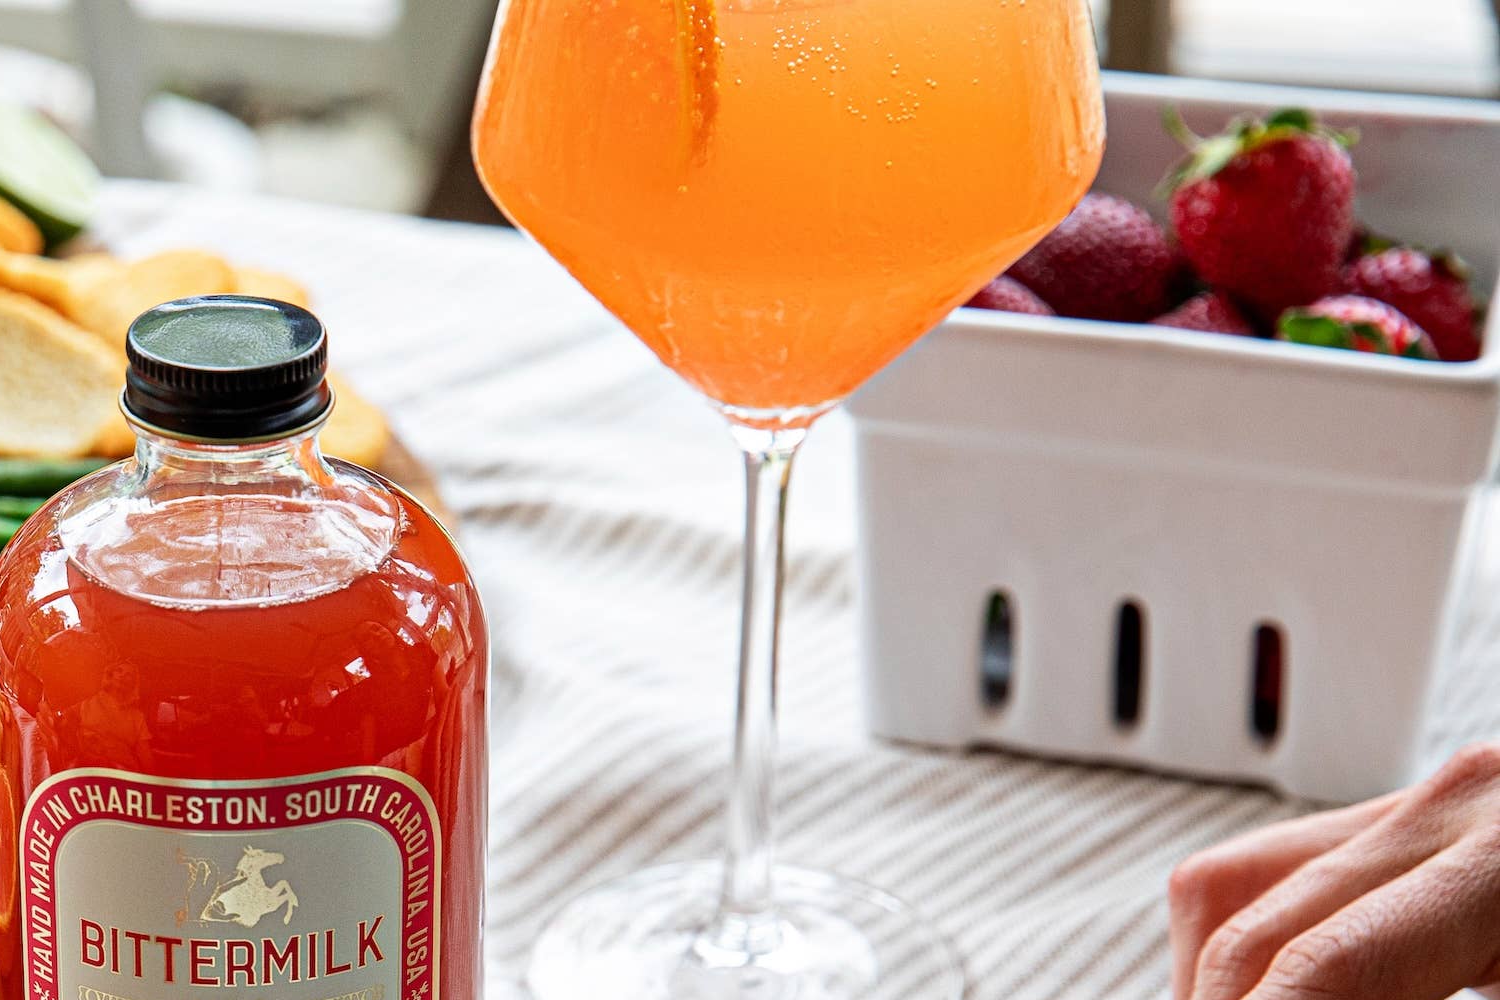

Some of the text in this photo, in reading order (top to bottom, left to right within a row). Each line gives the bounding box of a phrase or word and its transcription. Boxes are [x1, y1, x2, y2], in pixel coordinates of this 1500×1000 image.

[41, 794, 73, 831] IN
[285, 783, 382, 821] SOUTH
[29, 819, 56, 903] MADE
[30, 904, 53, 984] HAND
[79, 914, 386, 988] BITTERMILK
[406, 926, 429, 985] USA
